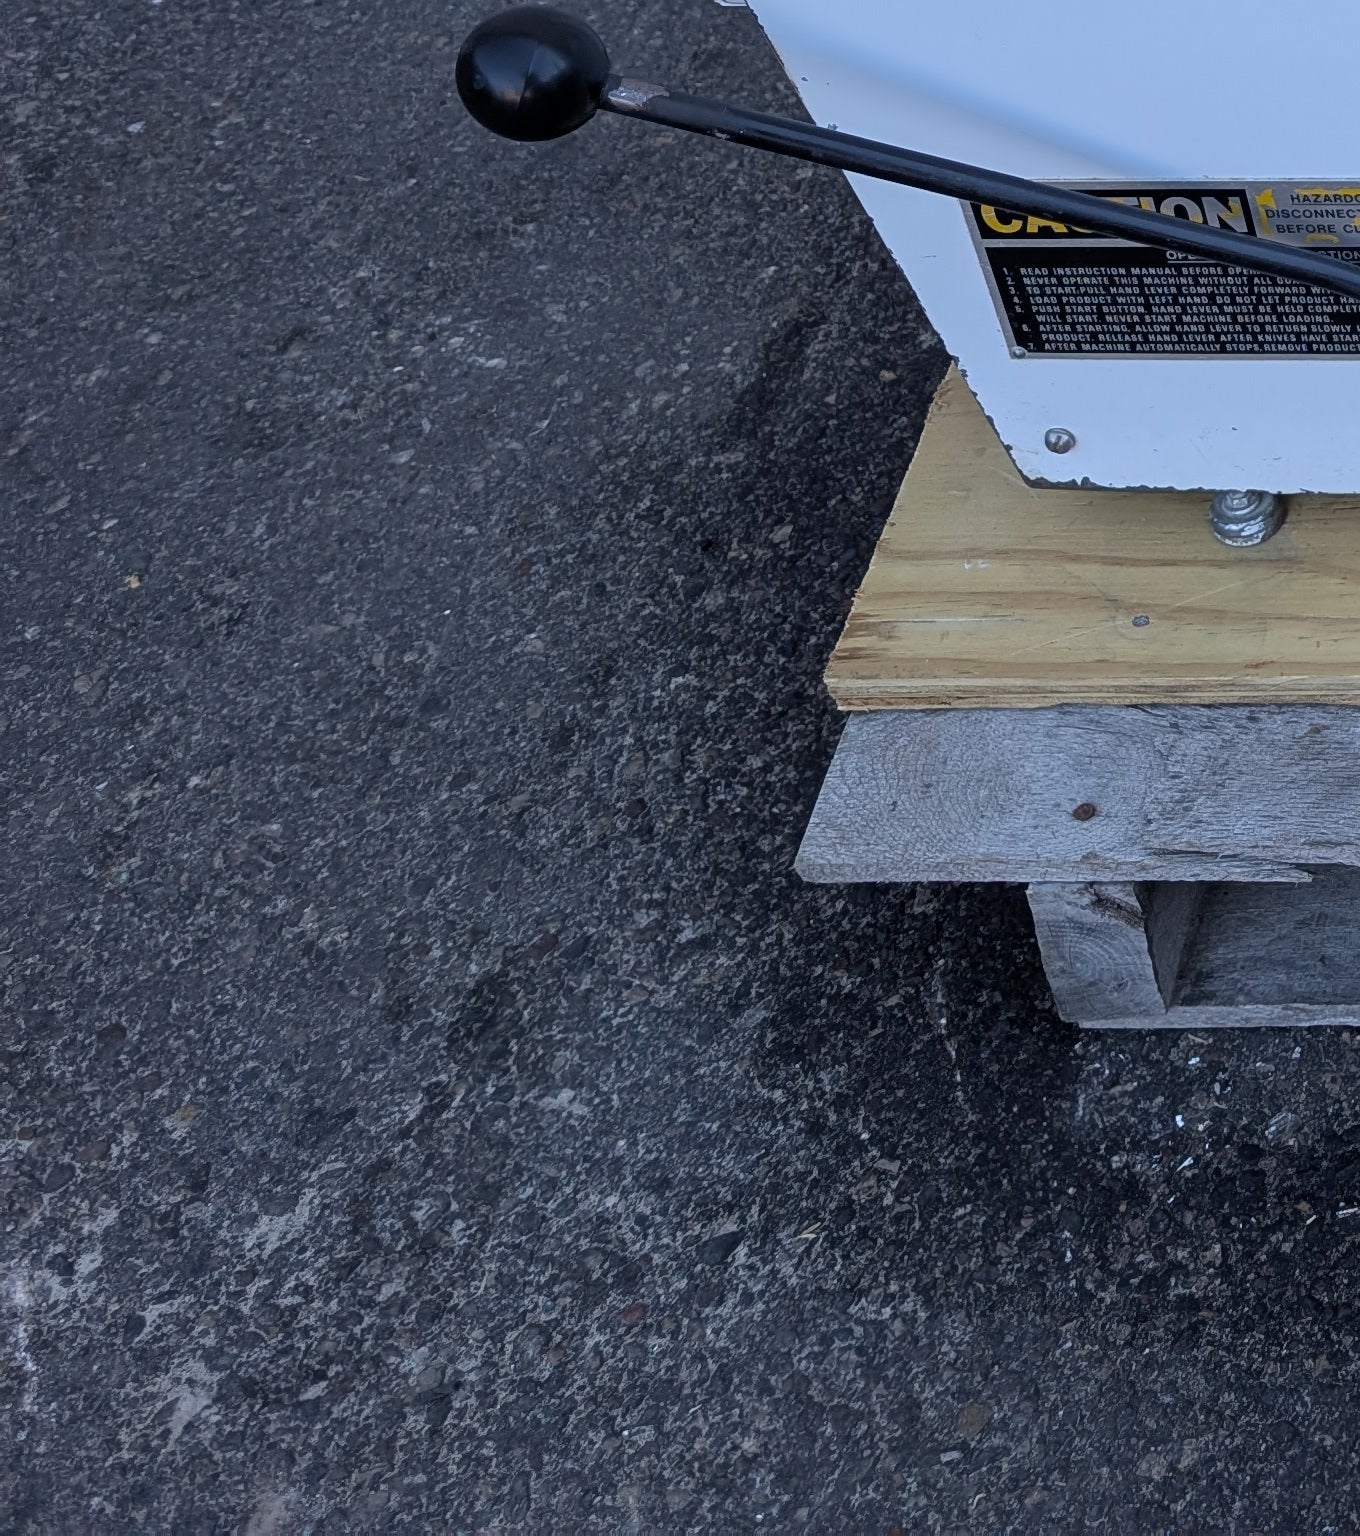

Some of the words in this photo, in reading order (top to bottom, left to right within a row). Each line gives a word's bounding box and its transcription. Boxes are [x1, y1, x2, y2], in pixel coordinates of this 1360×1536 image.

[1276, 223, 1337, 234] BEFORE
[1020, 267, 1049, 275] READ
[1053, 267, 1126, 275] INSTRUCTION
[1131, 267, 1178, 275] MANUAL
[1182, 267, 1223, 275] BEFORE
[1023, 276, 1058, 285] NEVER
[1062, 276, 1109, 285] OPERATE
[1114, 276, 1139, 285] THIS
[1143, 276, 1194, 285] MACHINE
[1198, 276, 1248, 285] WITHOUT
[1253, 276, 1272, 285] ALL
[1026, 286, 1041, 295] TO
[1110, 286, 1140, 295] HAND
[1145, 286, 1178, 295] LEVER
[1182, 286, 1250, 295] COMPLETELY
[1253, 286, 1306, 295] FORWARD
[1030, 296, 1058, 304] LOAD
[1062, 296, 1112, 304] PRODUCT
[1117, 296, 1145, 304] WITH
[1150, 296, 1173, 304] LEFT
[1216, 296, 1231, 304] DO
[1236, 296, 1257, 304] NOT
[1262, 296, 1280, 304] LET
[1285, 296, 1335, 304] PRODUCT
[1032, 305, 1061, 314] PUSH
[1065, 305, 1097, 314] START
[1152, 305, 1182, 314] HAND
[1187, 305, 1220, 314] LEVER
[1224, 305, 1254, 314] MUST
[1259, 305, 1273, 314] BE
[1277, 305, 1304, 314] HELD
[1036, 315, 1062, 323] WILL
[1106, 315, 1140, 323] NEVER
[1145, 315, 1177, 323] START
[1182, 315, 1233, 323] MACHINE
[1237, 315, 1279, 323] BEFORE
[1283, 315, 1334, 323] LOADING.
[1040, 324, 1072, 333] AFTER
[1135, 324, 1171, 333] ALLOW
[1175, 324, 1206, 333] HAND
[1210, 324, 1243, 333] LEVER
[1246, 324, 1261, 333] TO
[1265, 324, 1308, 333] RETURN
[1311, 324, 1352, 333] SLOWLY
[1098, 334, 1145, 342] RELEASE
[1149, 334, 1179, 342] HAND
[1183, 334, 1216, 342] LEVER
[1220, 334, 1253, 342] AFTER
[1258, 334, 1297, 342] KNIVES
[1301, 334, 1329, 342] HAVE
[1044, 343, 1077, 352] AFTER
[1081, 343, 1130, 352] MACHINE
[1135, 343, 1221, 352] AUTOMATICALLY
